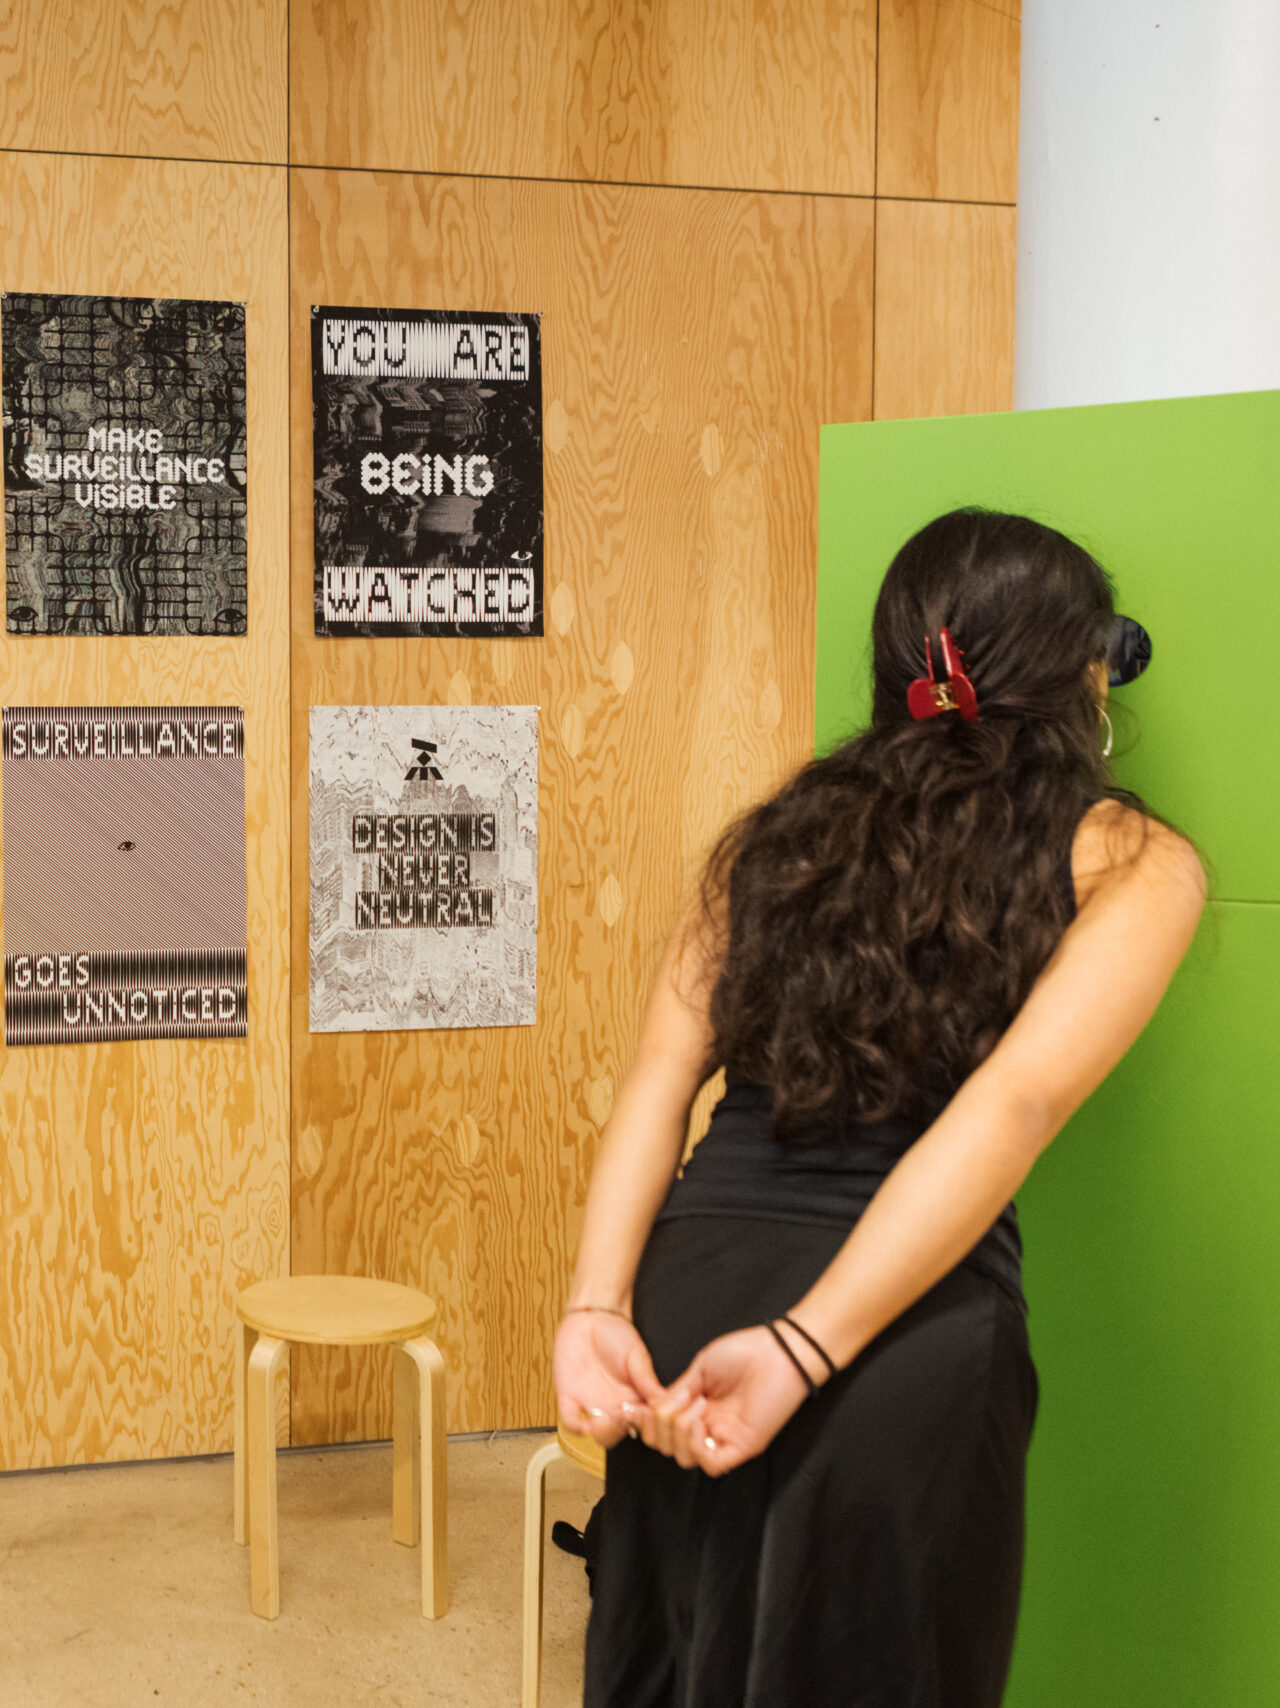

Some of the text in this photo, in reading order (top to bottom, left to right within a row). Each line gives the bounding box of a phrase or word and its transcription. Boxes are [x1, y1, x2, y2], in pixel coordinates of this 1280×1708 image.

[325, 321, 527, 377] YOU ARE
[87, 426, 164, 454] MAKE
[324, 570, 532, 619] WATCHED
[12, 722, 235, 755] SURVEILLANCE
[353, 814, 496, 852] DESIGN IS
[378, 852, 470, 889] NEVER
[355, 890, 492, 927] NEUTRAL
[14, 955, 90, 988] GOES
[62, 988, 236, 1024] UNNOTICED
